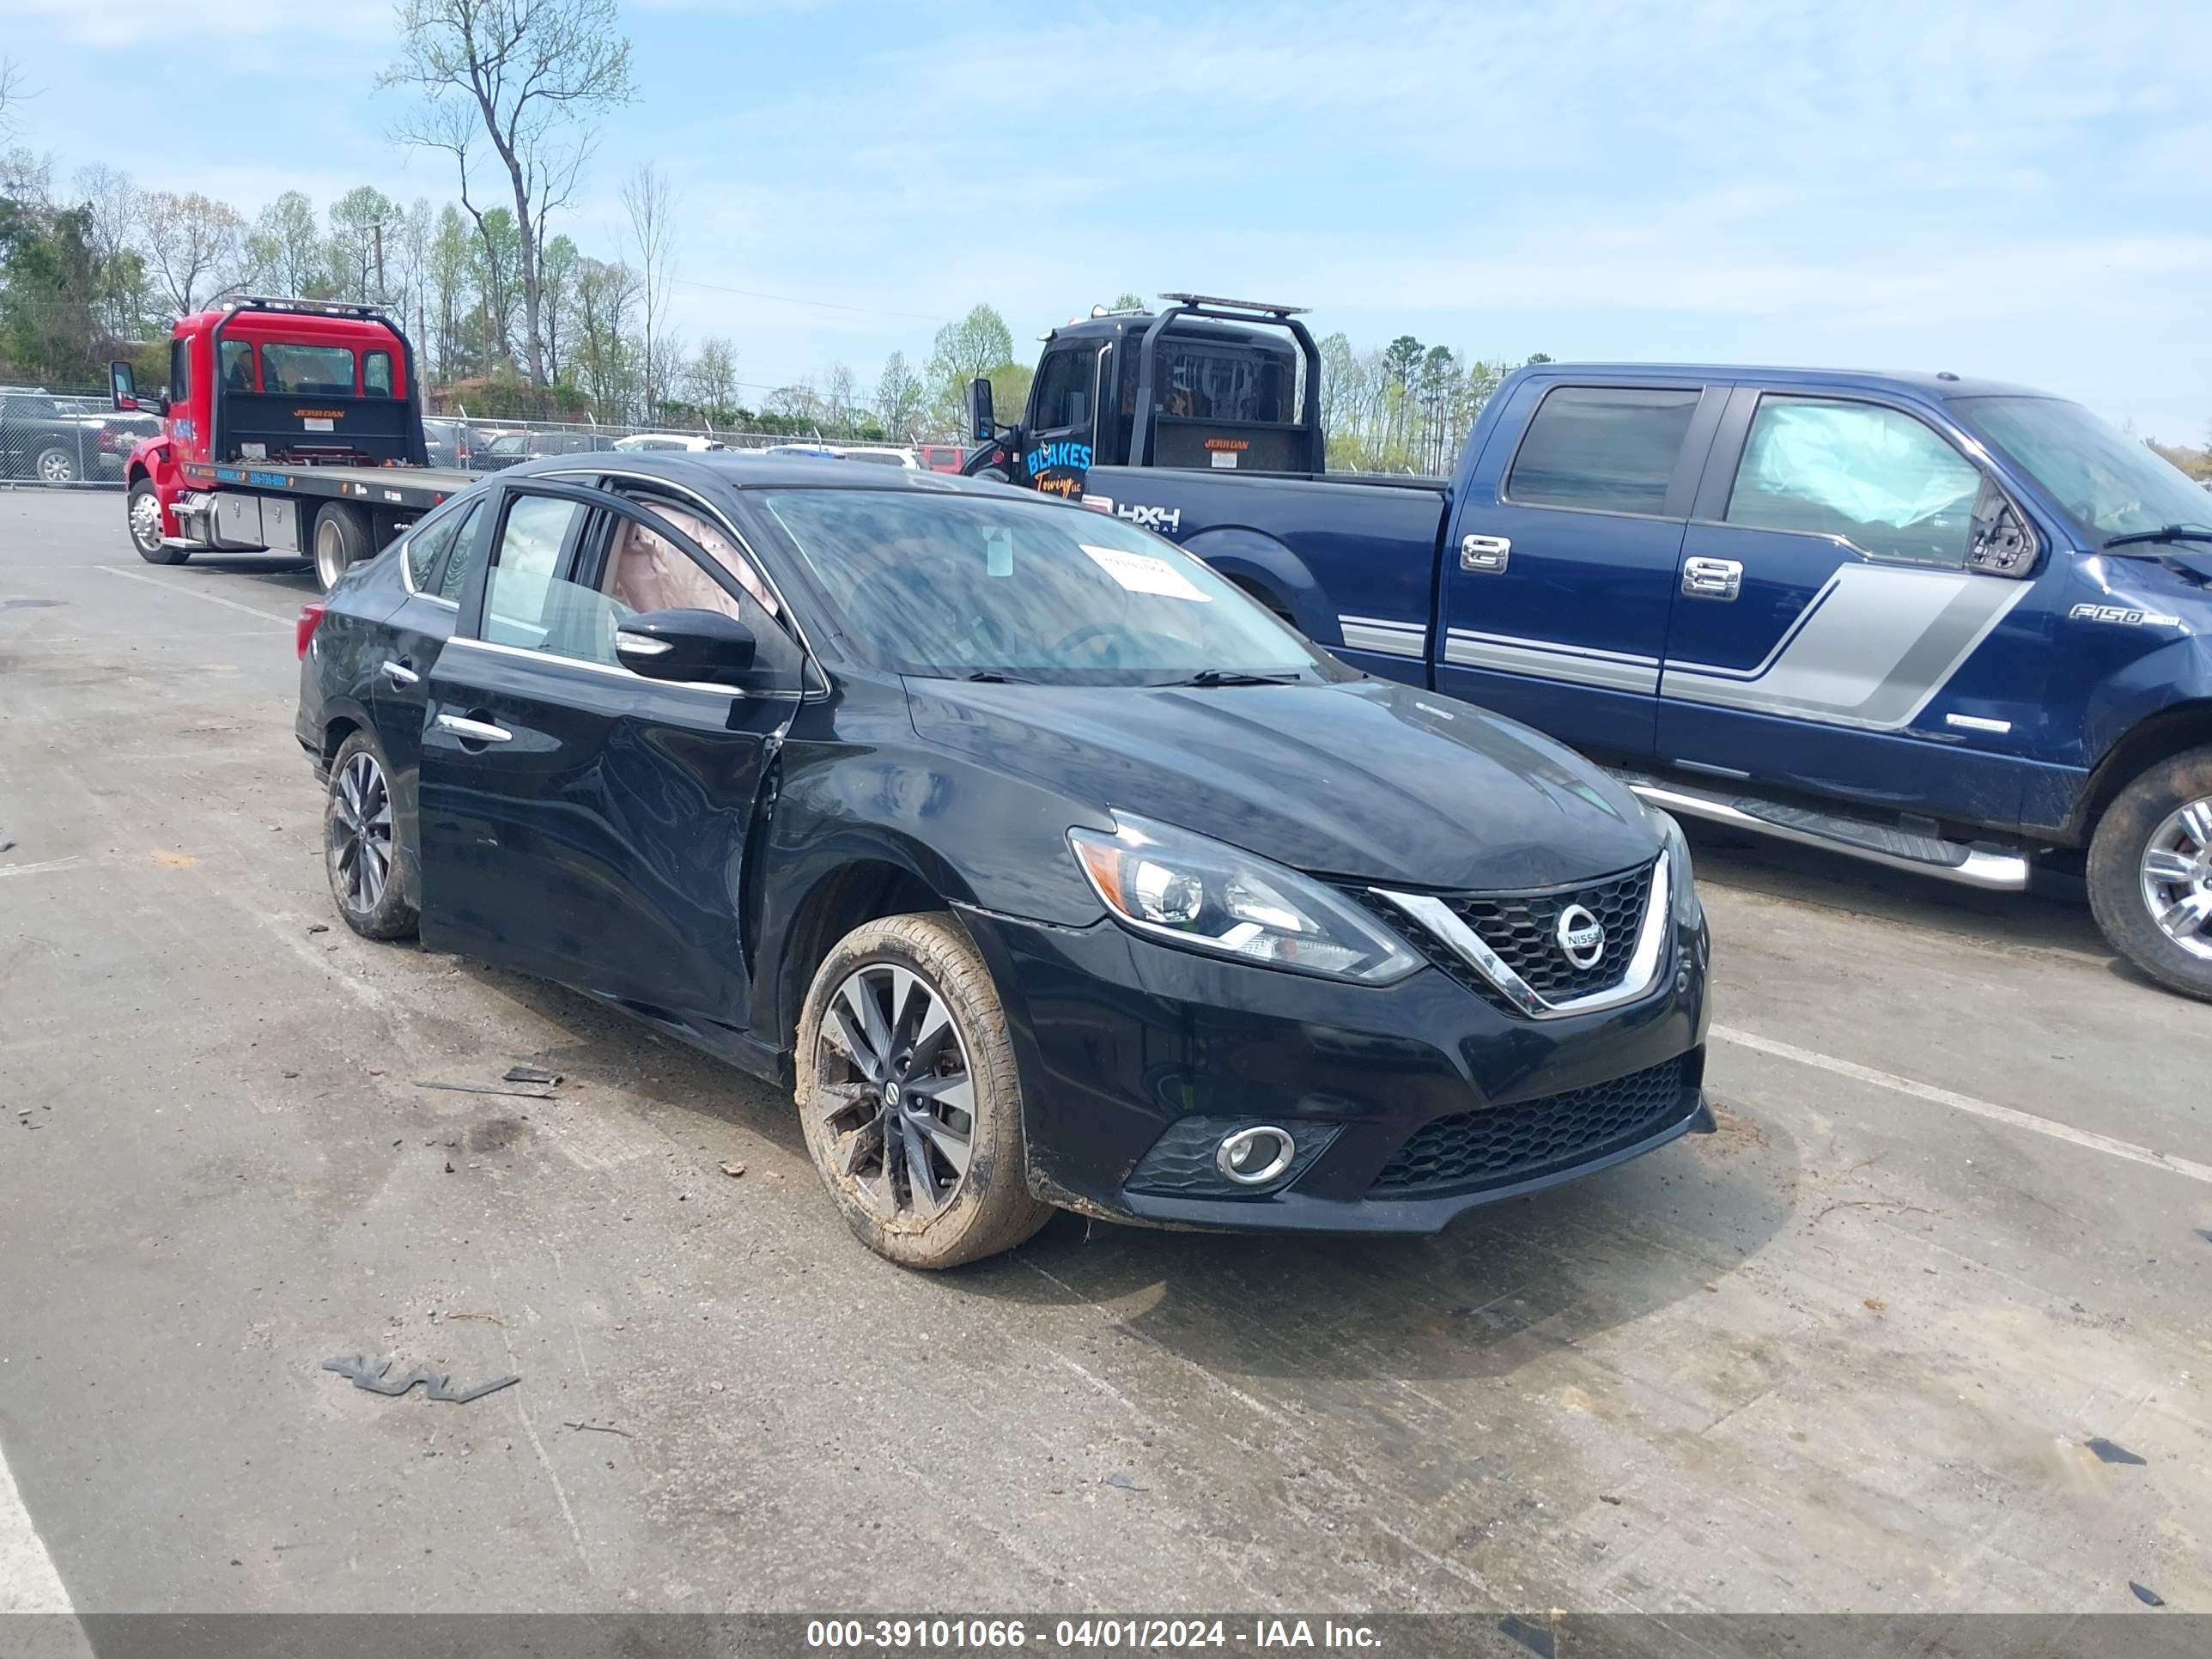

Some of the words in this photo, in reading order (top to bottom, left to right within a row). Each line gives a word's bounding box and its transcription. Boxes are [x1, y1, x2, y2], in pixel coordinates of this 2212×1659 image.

[1027, 442, 1092, 476] BLAKES
[1035, 469, 1073, 499] Towing
[1567, 932, 1601, 945] NISSA
